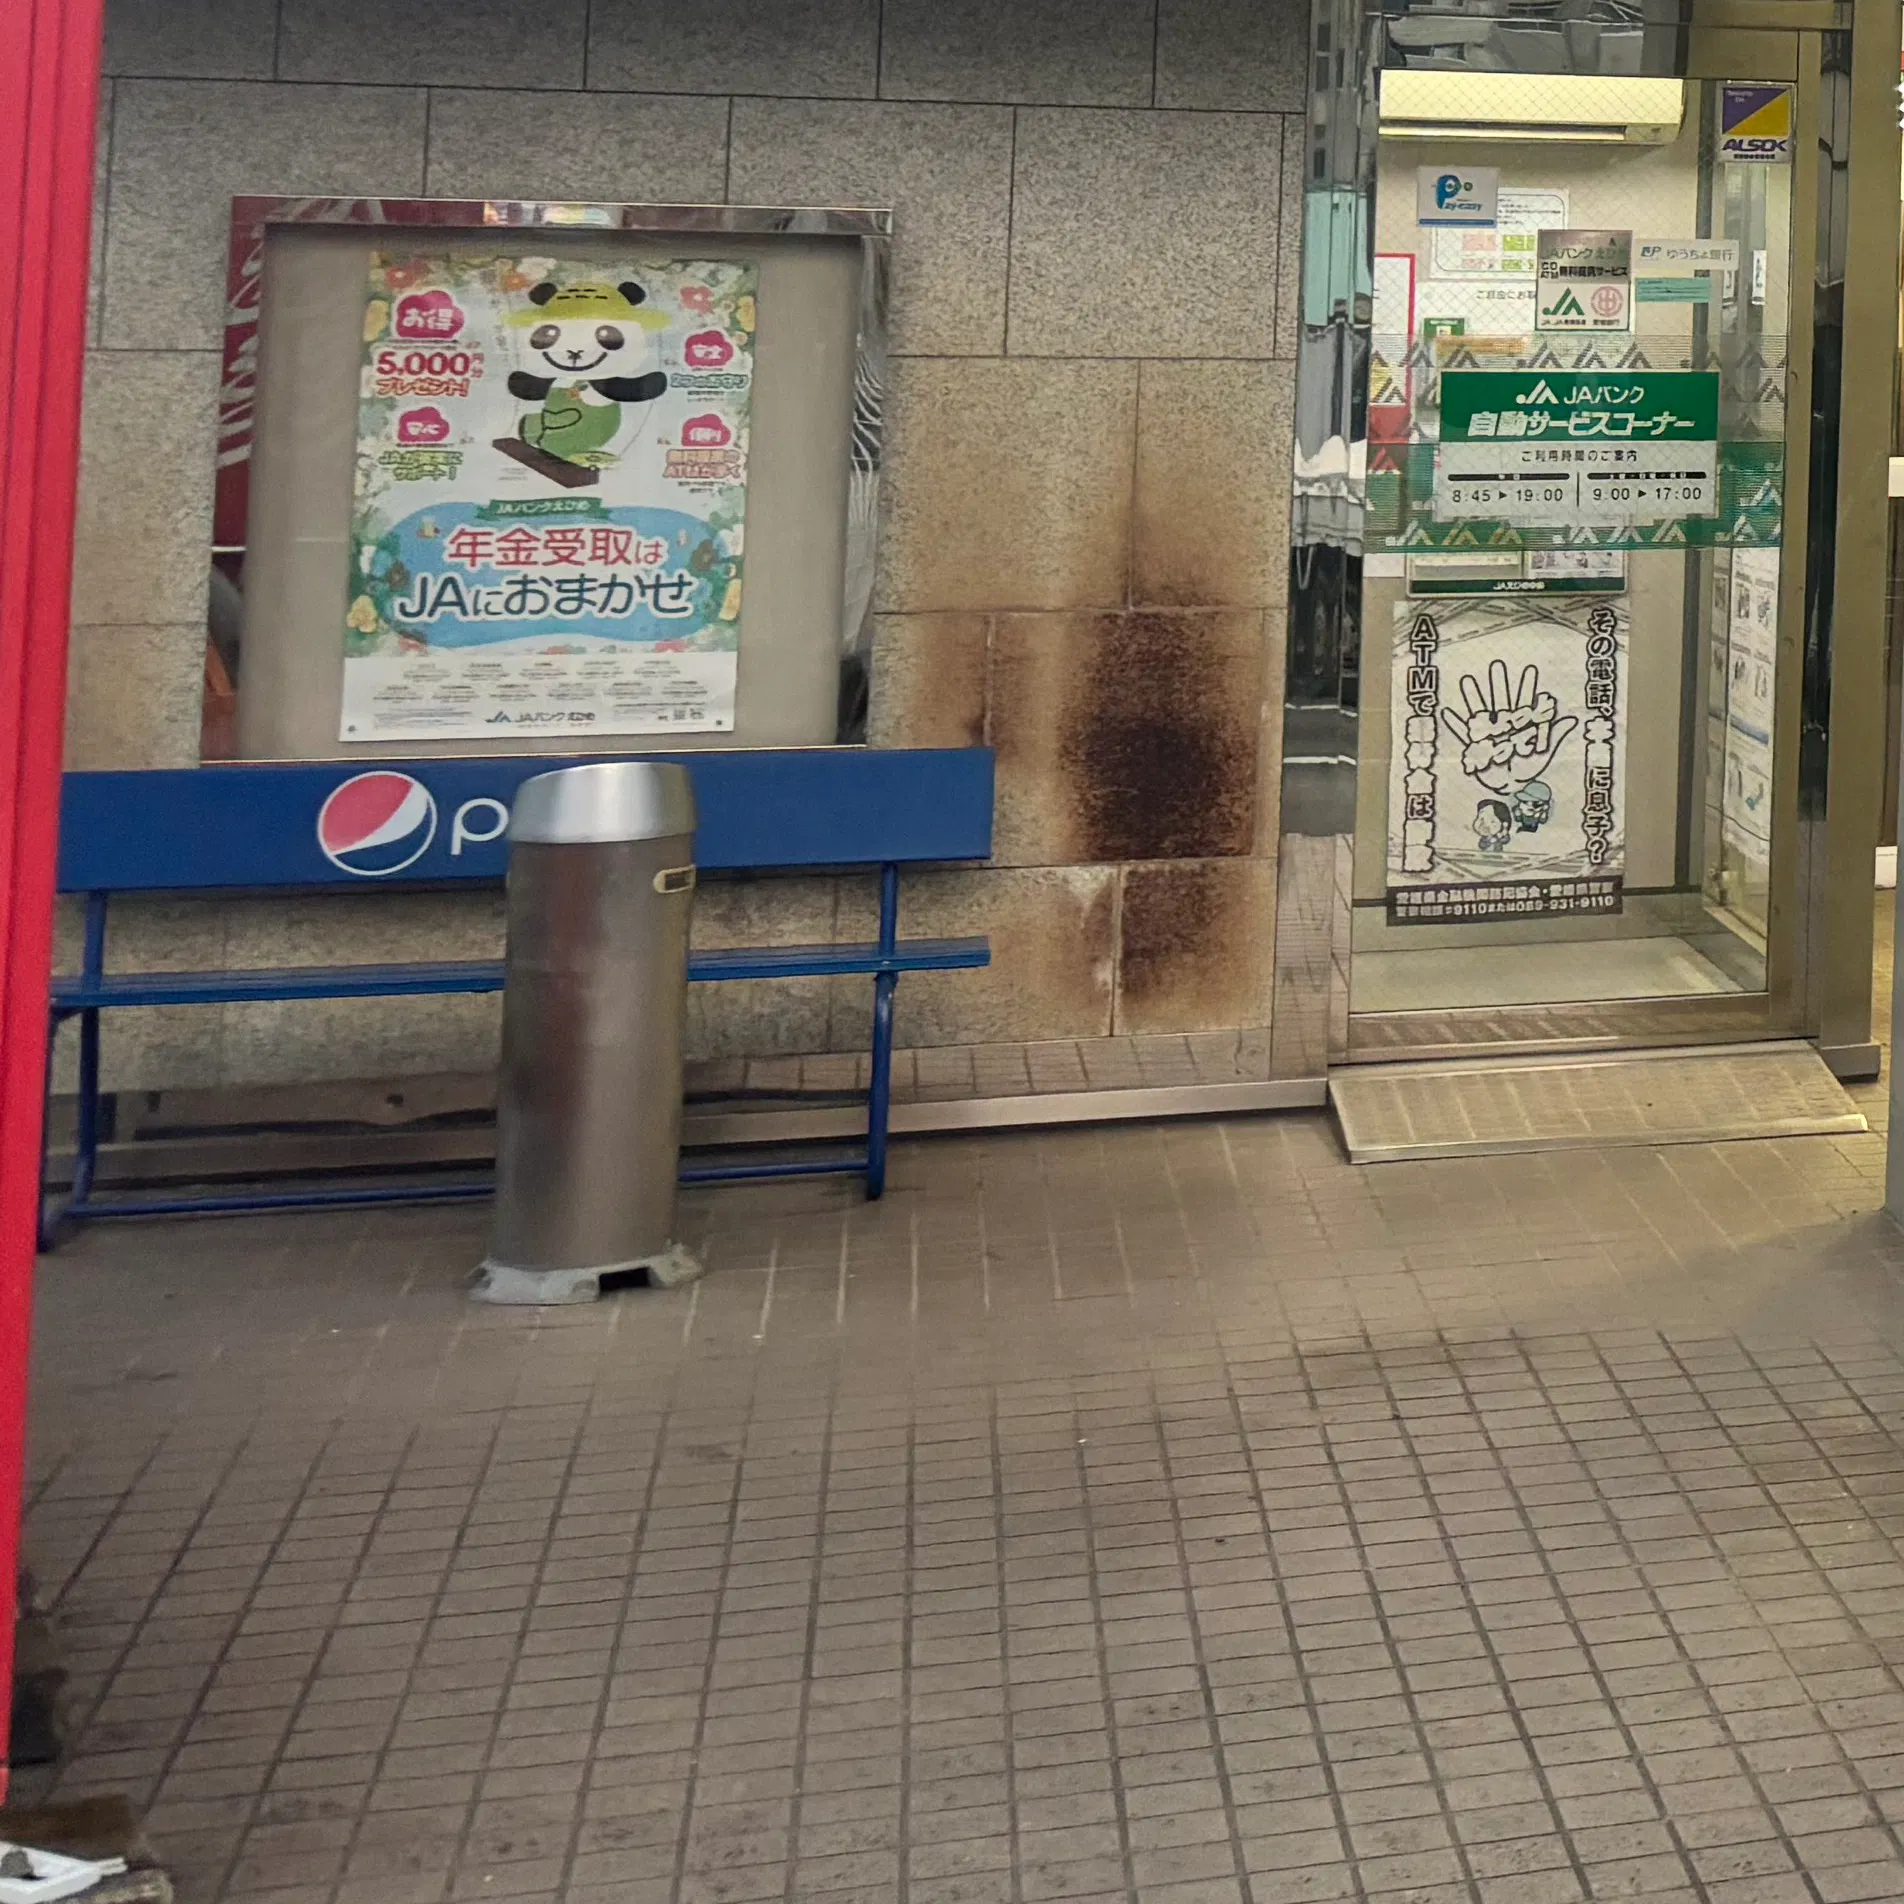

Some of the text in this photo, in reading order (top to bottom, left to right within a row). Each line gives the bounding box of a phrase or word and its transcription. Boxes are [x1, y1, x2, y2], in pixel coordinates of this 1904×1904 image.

[1722, 139, 1787, 152] ALSOK
[1563, 386, 1645, 405] JAバンク
[1467, 410, 1695, 437] 自動サービスコーナー
[1452, 488, 1564, 503] 8:45 19:00
[1592, 487, 1702, 500] 9:00 17:00
[448, 527, 664, 567] 年金受取は
[399, 573, 693, 618] JAにおまかせ
